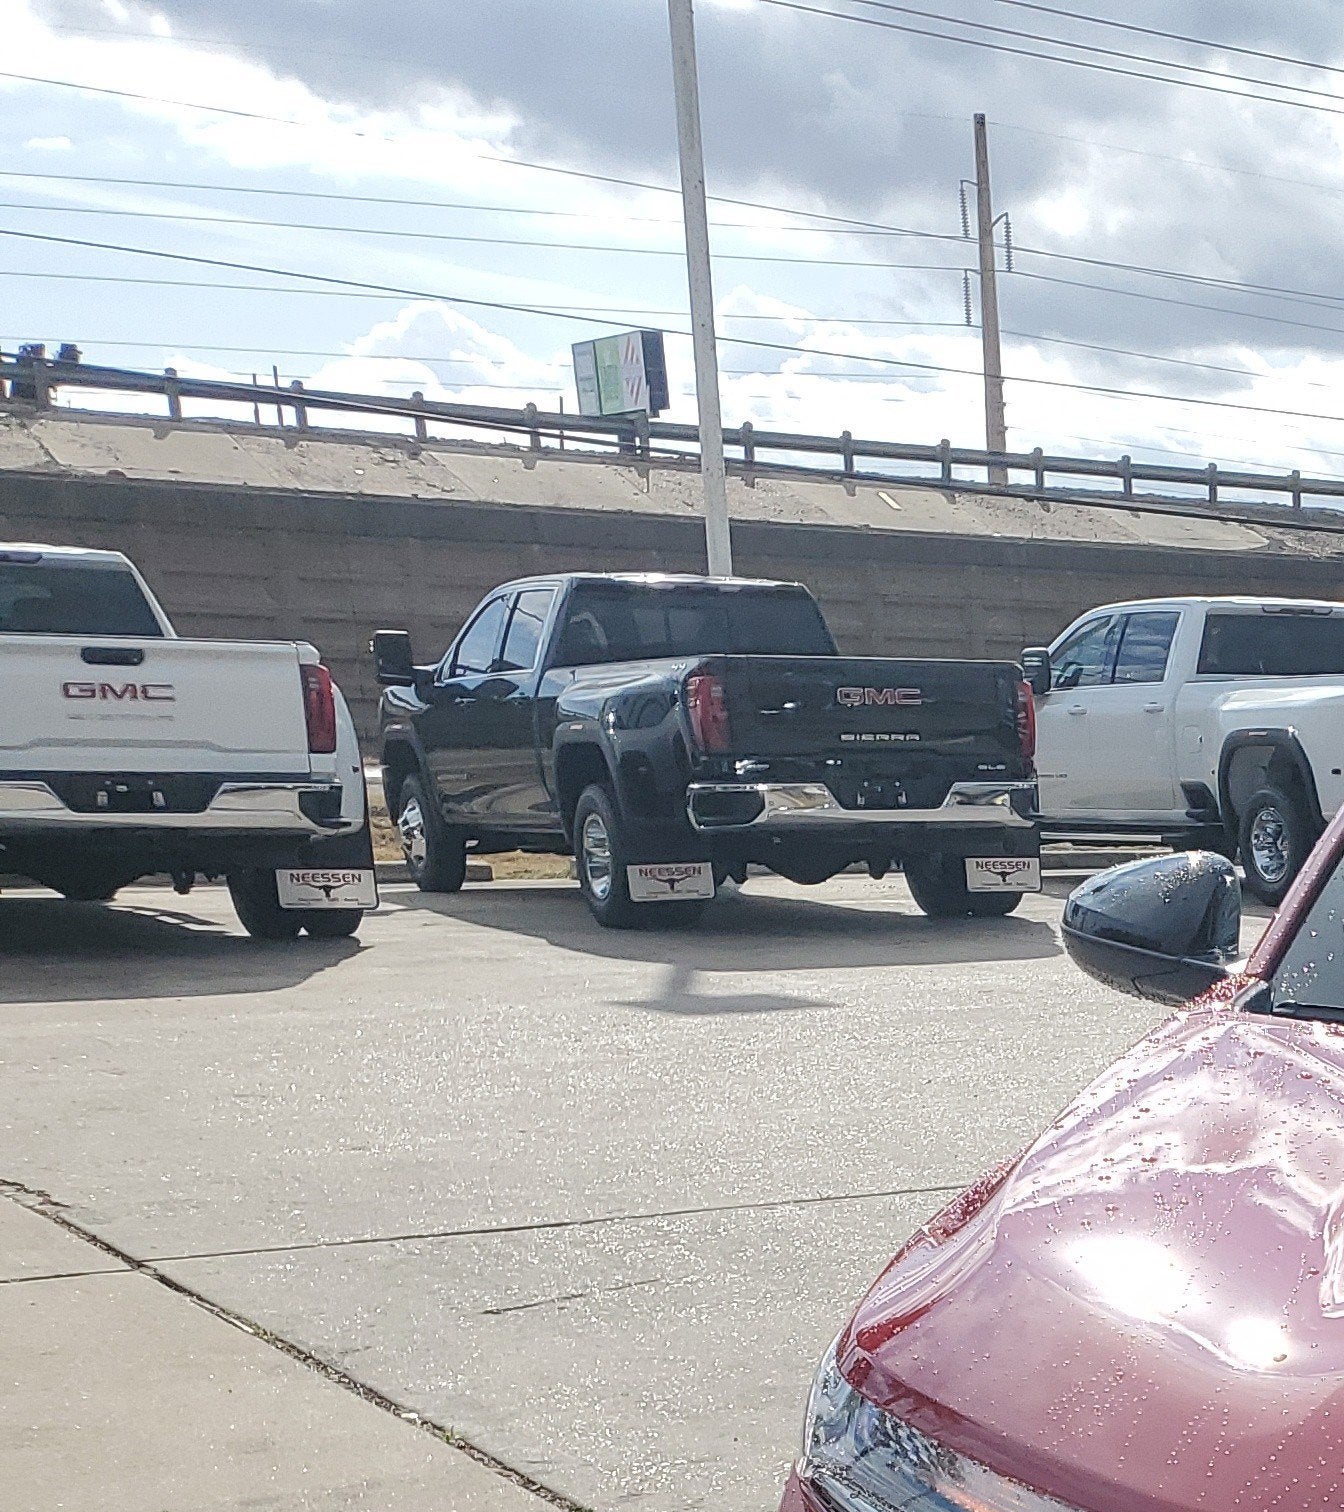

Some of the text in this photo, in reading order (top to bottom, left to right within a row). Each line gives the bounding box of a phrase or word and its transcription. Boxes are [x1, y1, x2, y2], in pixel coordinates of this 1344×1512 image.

[62, 682, 175, 702] GMC
[837, 687, 922, 706] GMC
[289, 873, 362, 883] NEESSEN
